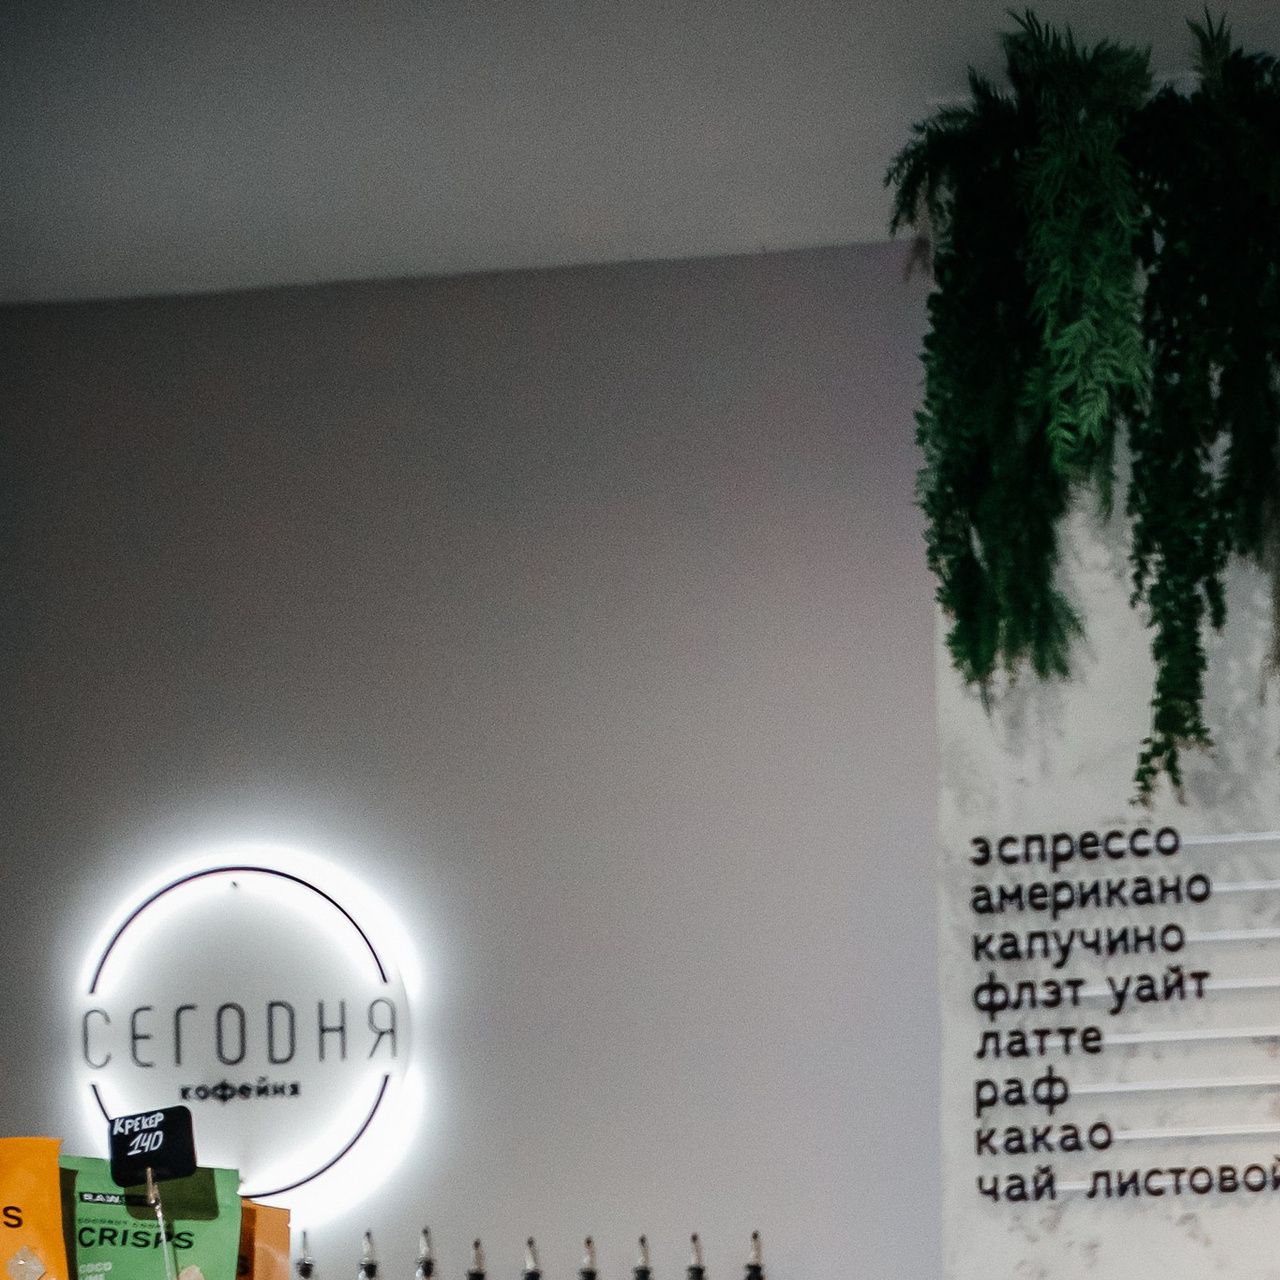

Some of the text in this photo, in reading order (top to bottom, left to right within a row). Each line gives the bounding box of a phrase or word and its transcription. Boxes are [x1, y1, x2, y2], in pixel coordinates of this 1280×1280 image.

[969, 826, 1181, 873] эспрессо
[970, 873, 1212, 920] американо
[972, 923, 1186, 969] капучино
[973, 970, 1086, 1022] флэт
[1107, 965, 1211, 1015] уайт
[82, 998, 398, 1070] СЕГОДНЯ
[976, 1025, 1103, 1059] латте
[180, 1076, 300, 1105] кофейня
[975, 1064, 1070, 1118] раф
[127, 1130, 165, 1156] 140
[975, 1121, 1112, 1156] какао
[977, 1165, 1057, 1201] чай
[78, 1226, 195, 1249] CRISPS
